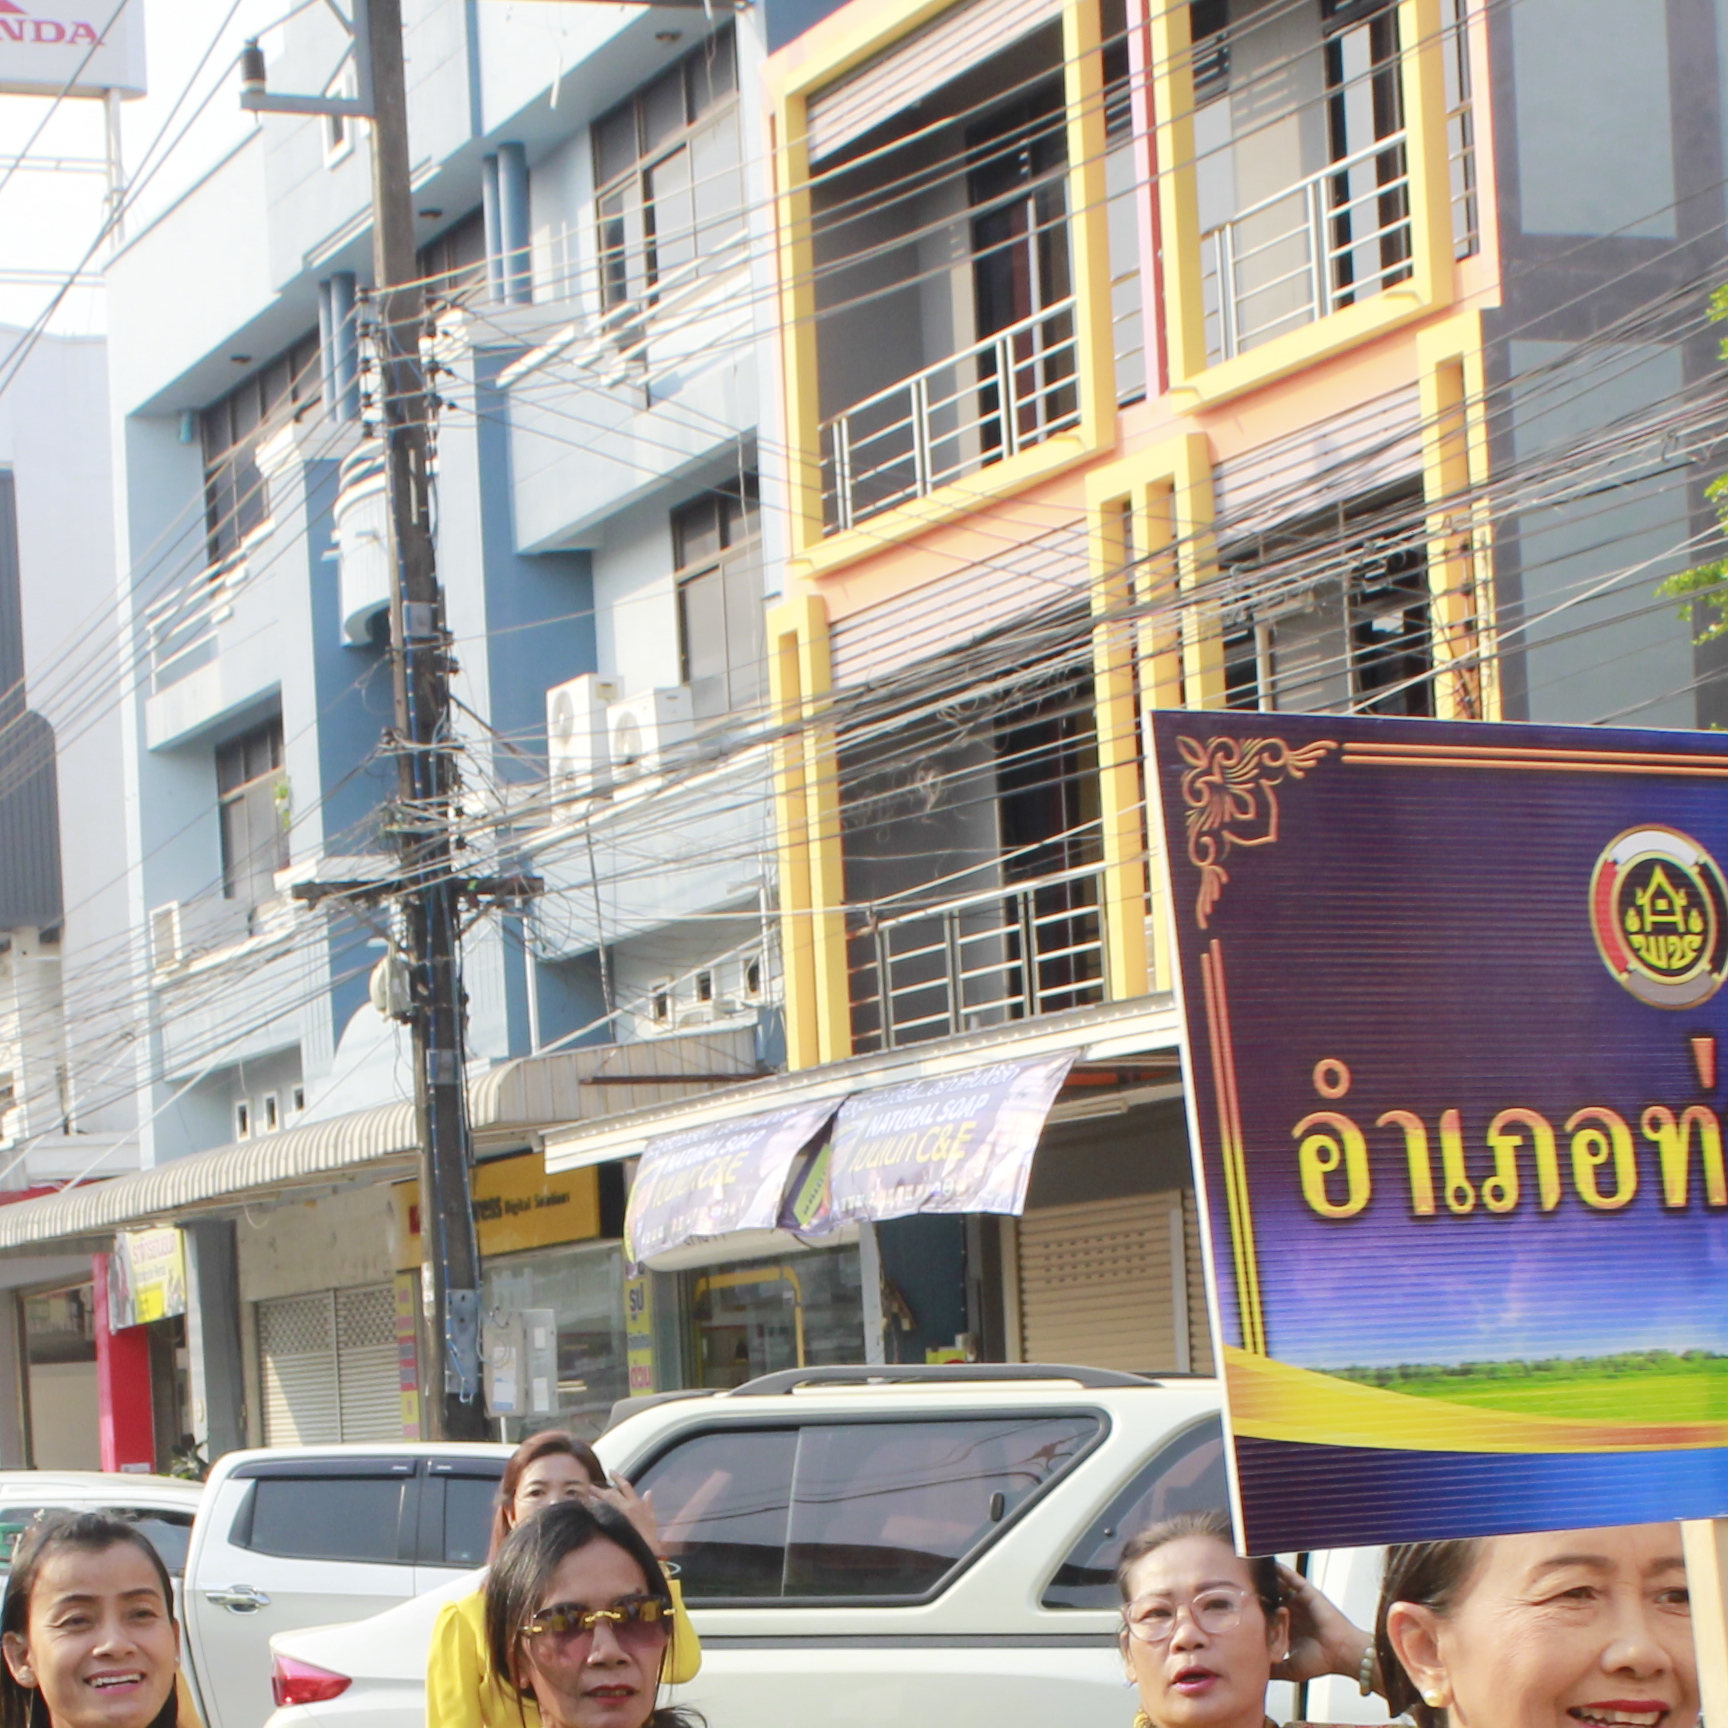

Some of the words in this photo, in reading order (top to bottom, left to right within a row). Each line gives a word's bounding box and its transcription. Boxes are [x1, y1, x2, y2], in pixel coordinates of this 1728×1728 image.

[865, 1103, 940, 1139] NATURAL
[936, 1092, 991, 1123] SOAP
[663, 1143, 722, 1173] NATURAL
[721, 1129, 767, 1155] SOAP
[915, 1120, 978, 1164] C&E
